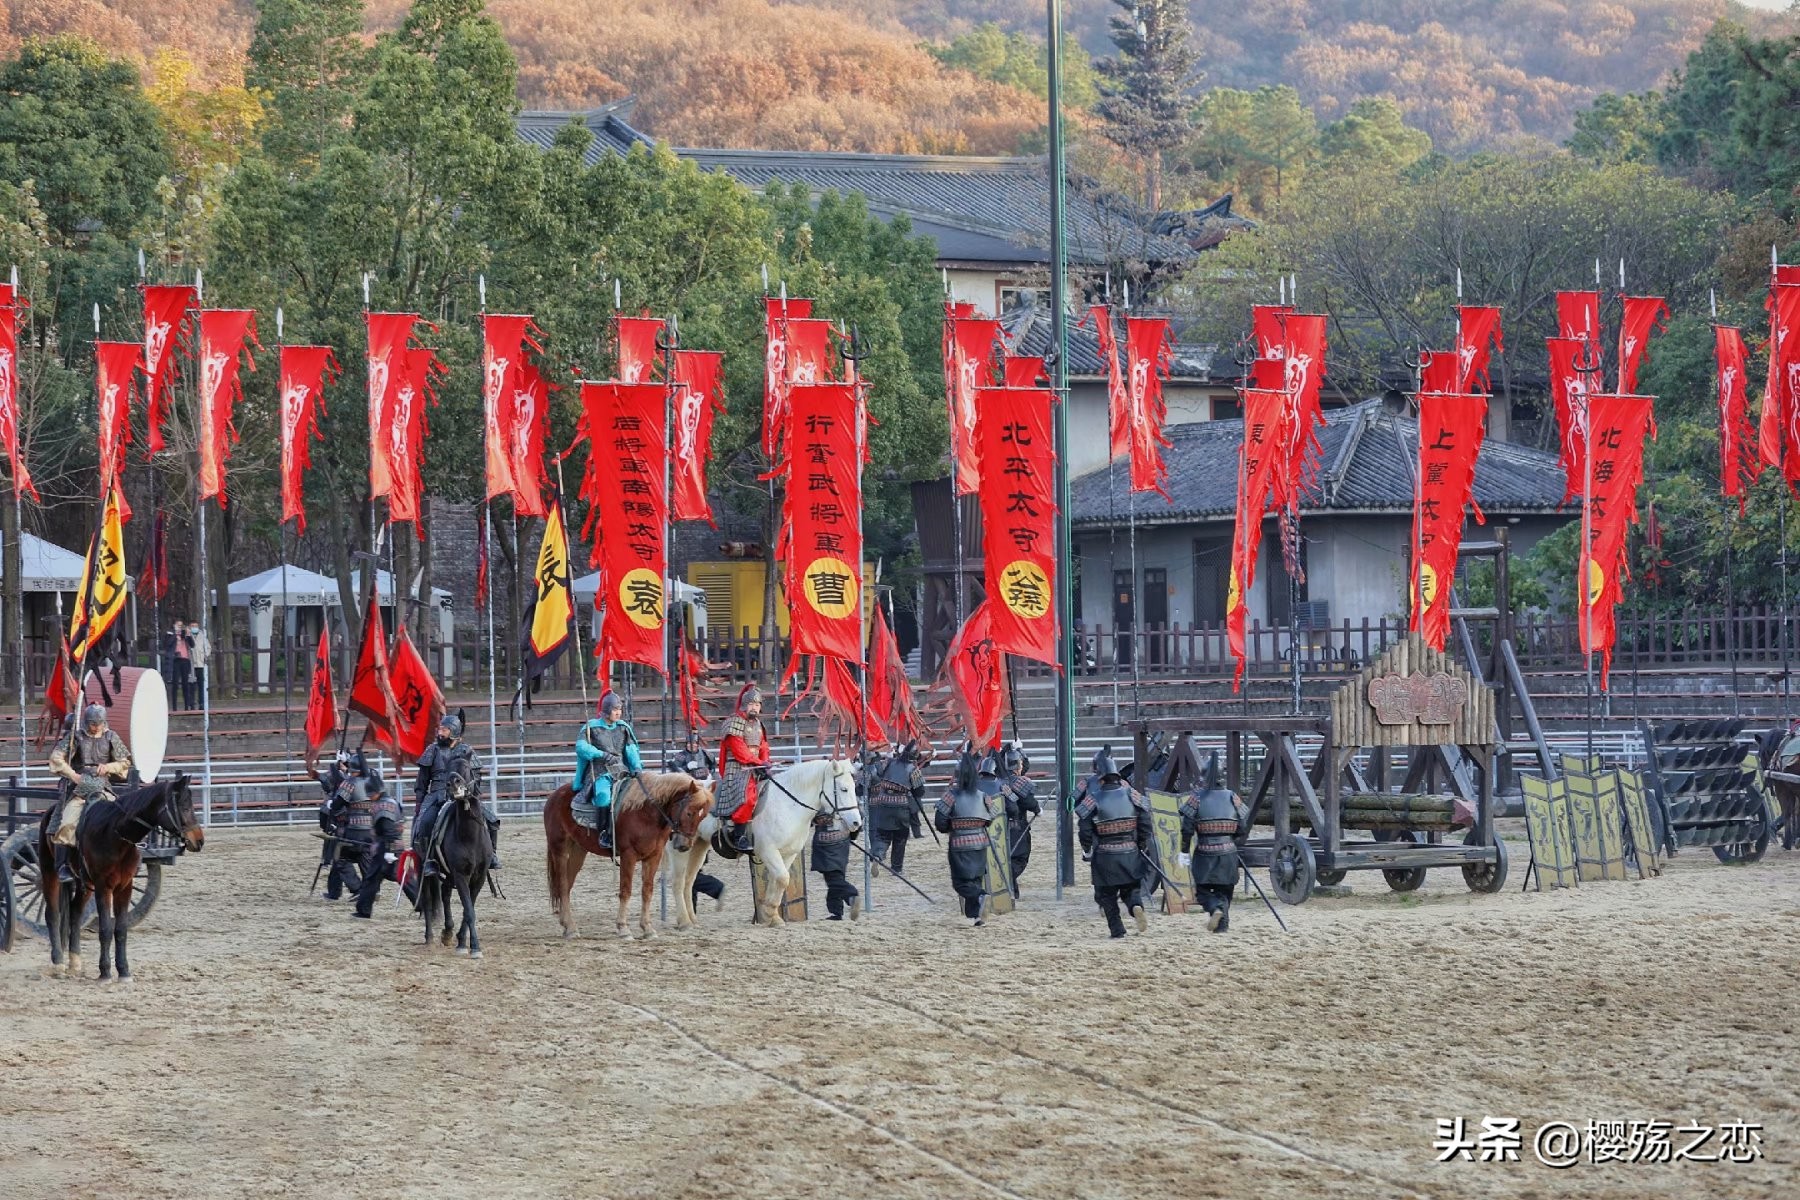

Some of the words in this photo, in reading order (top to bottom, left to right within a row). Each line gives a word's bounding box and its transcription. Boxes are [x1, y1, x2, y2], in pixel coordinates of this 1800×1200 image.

[1001, 421, 1040, 552] 北平太守
[626, 579, 663, 621] 袁
[807, 571, 850, 605] 曹
[1007, 570, 1045, 611] 公孫
